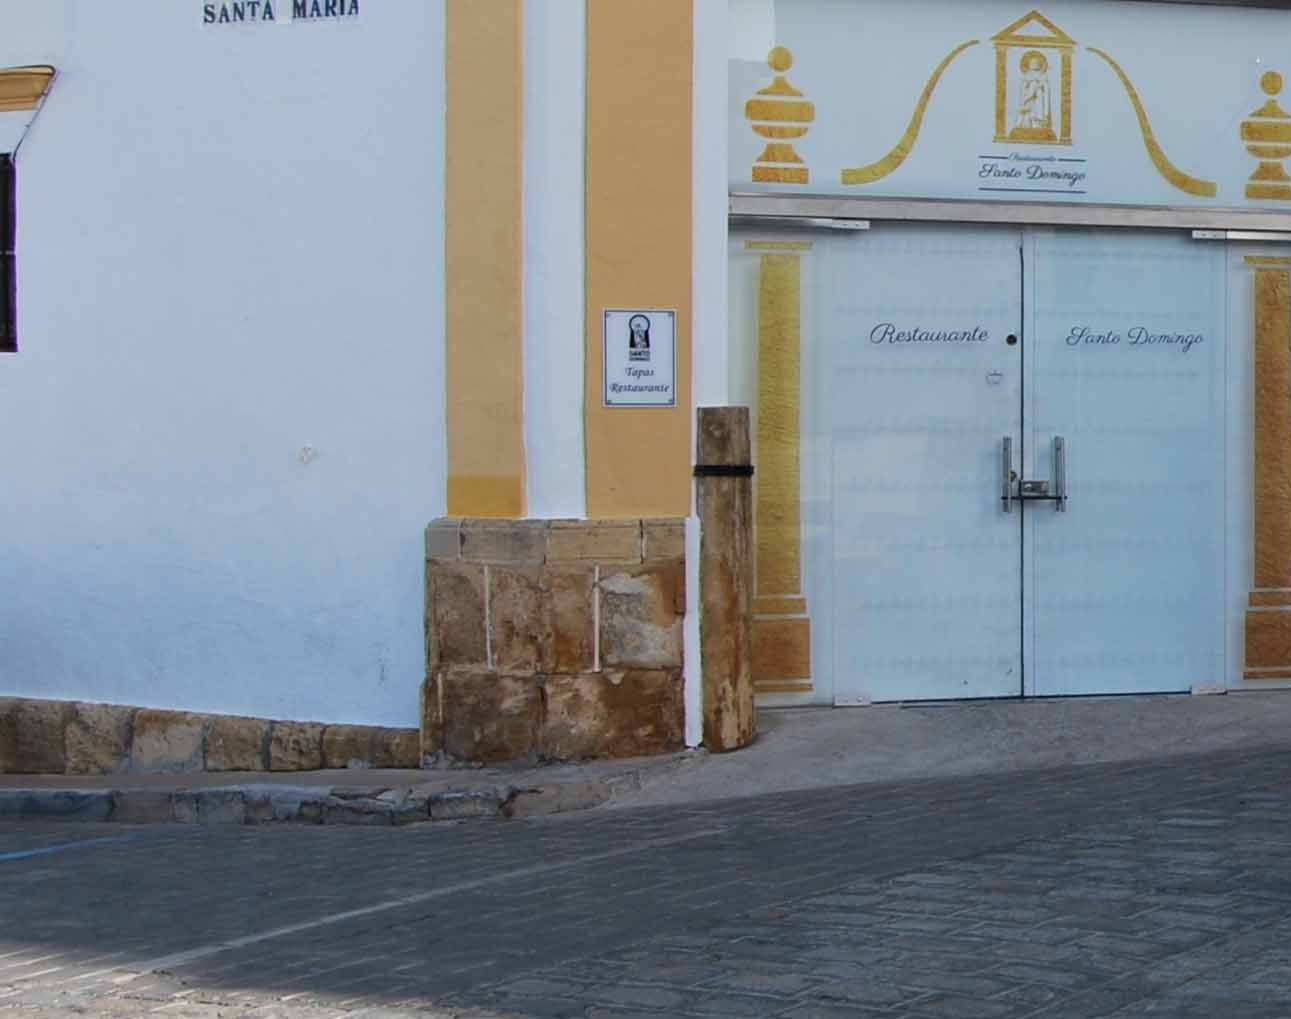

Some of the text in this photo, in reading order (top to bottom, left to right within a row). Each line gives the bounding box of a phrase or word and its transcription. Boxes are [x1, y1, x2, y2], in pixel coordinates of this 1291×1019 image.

[203, 0, 275, 23] SANTA
[978, 163, 1086, 187] Santo Domingo
[870, 323, 1203, 352] Restaurante Santo Domingo
[625, 367, 655, 380] Tapas
[609, 383, 670, 394] Restaurante
